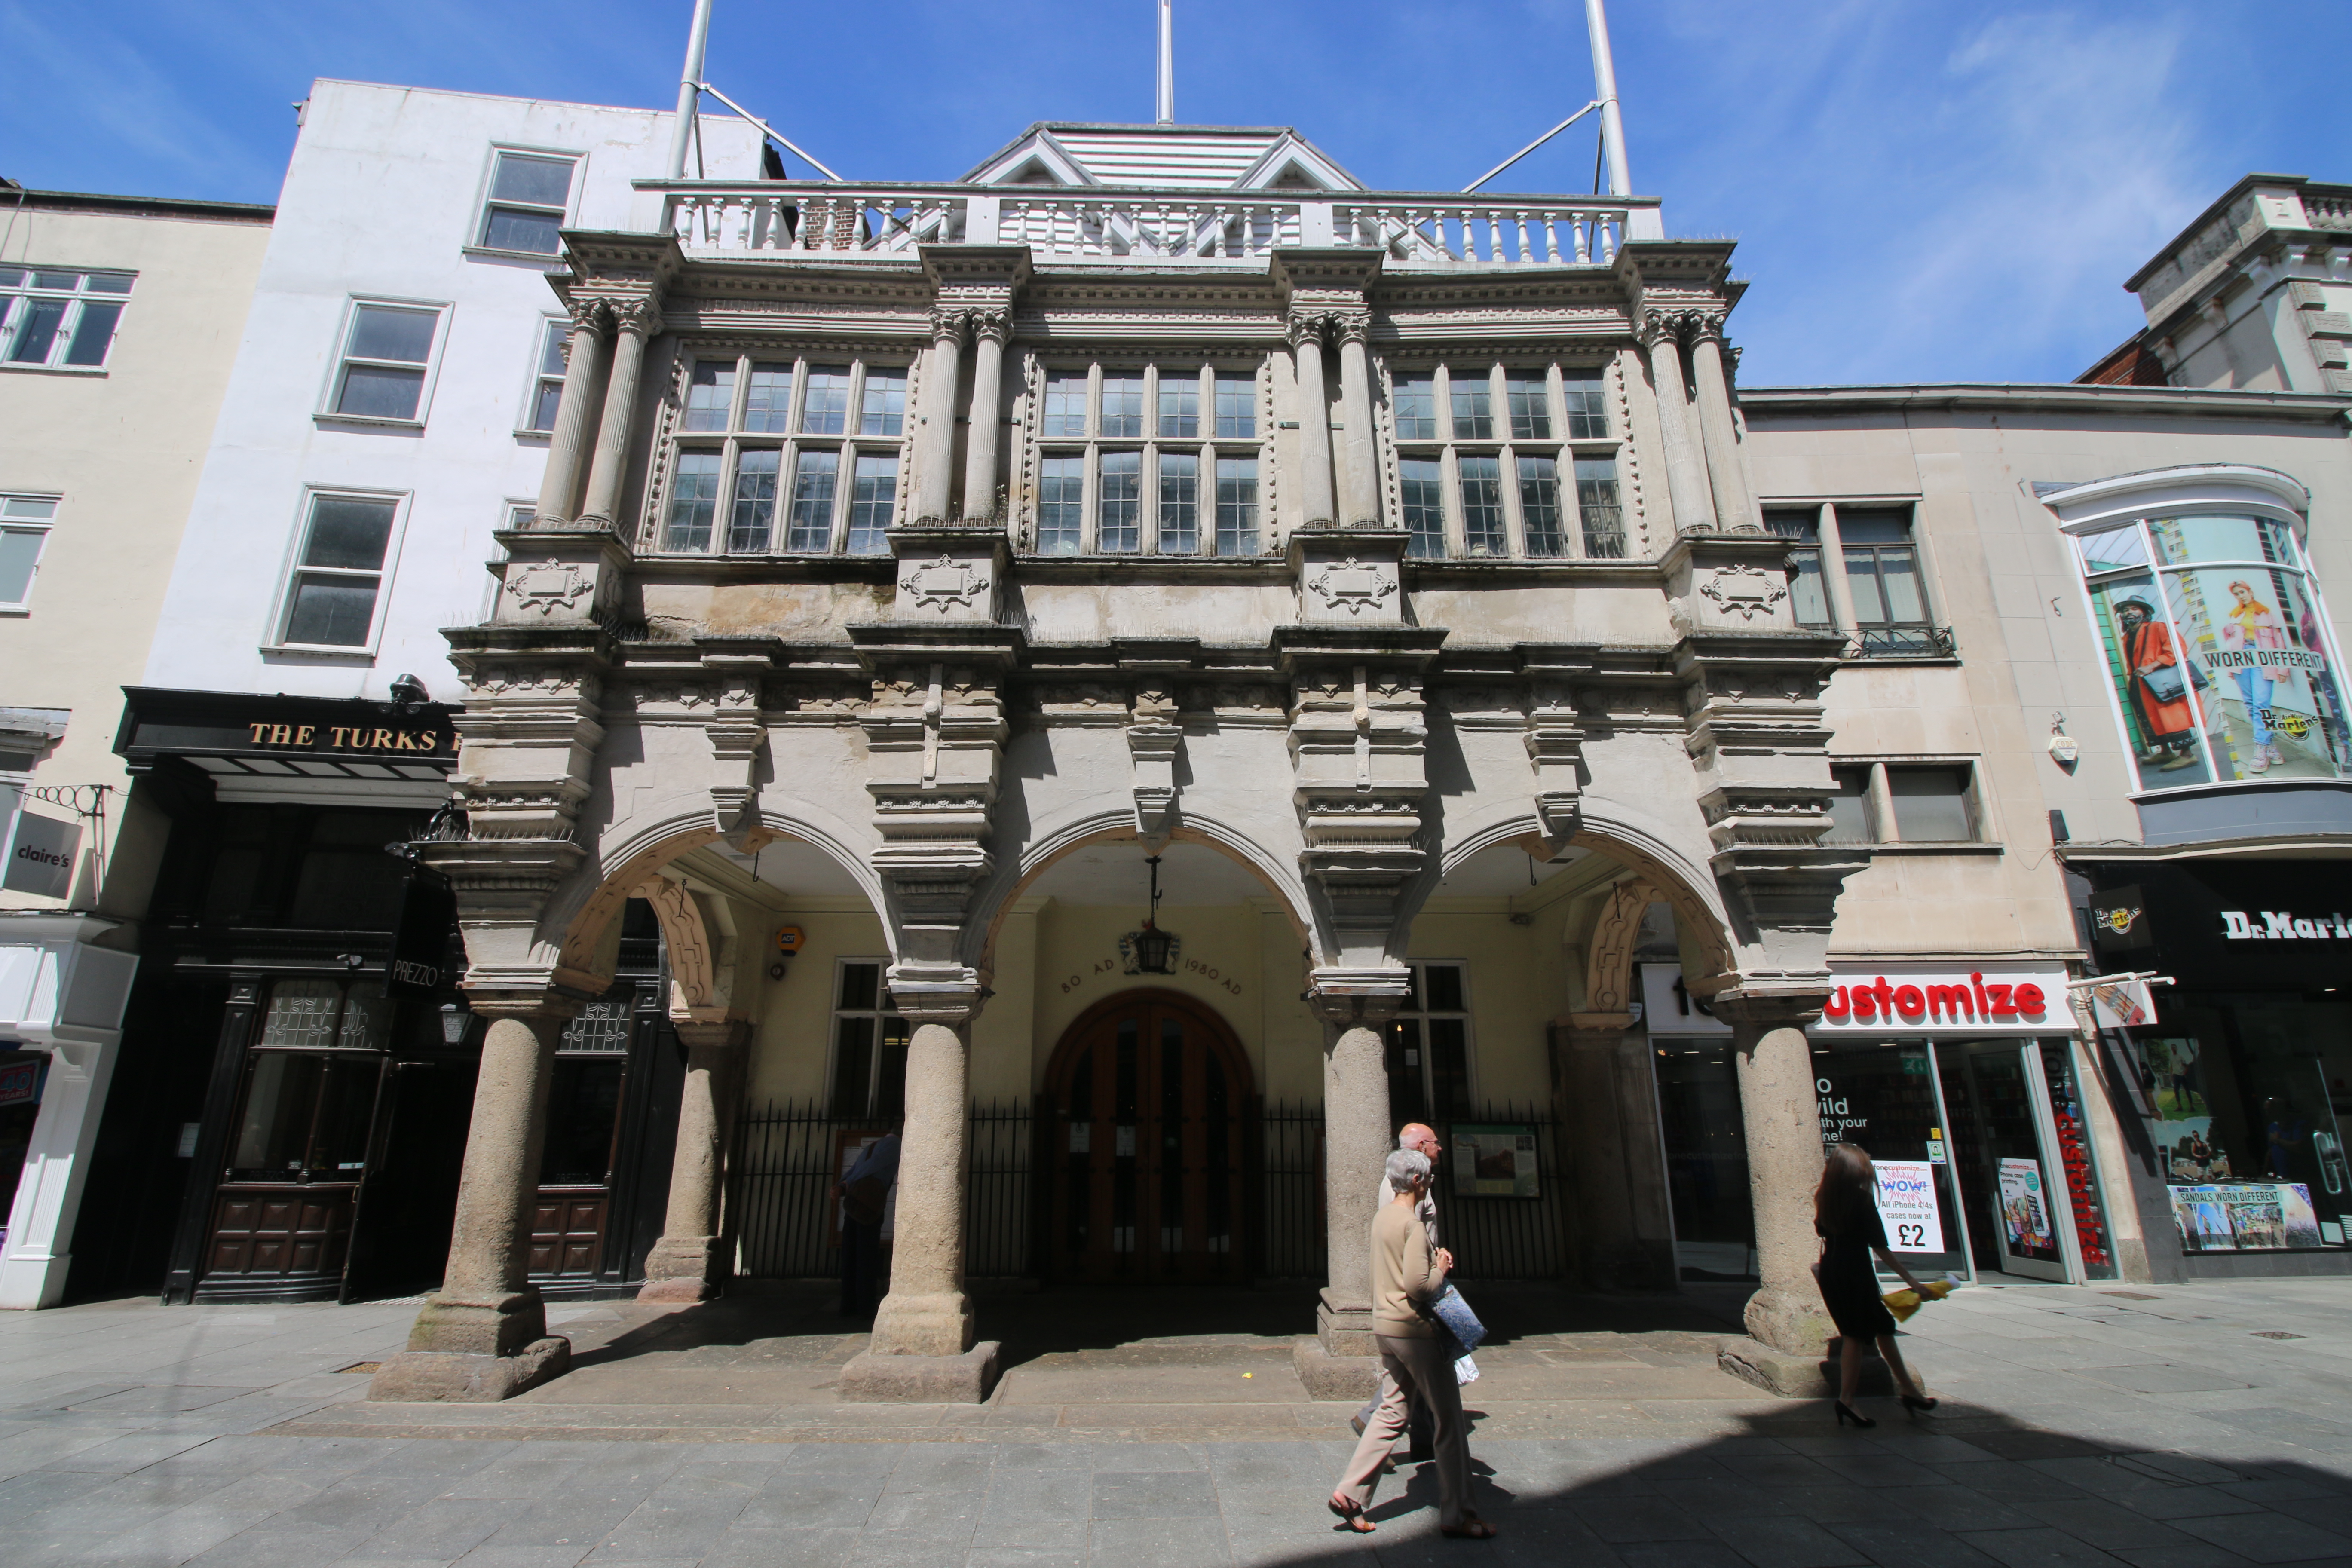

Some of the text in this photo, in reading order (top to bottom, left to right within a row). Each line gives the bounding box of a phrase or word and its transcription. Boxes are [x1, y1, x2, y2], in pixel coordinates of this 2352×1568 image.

[2205, 652, 2322, 669] WORN DIFFERENT
[2263, 716, 2319, 730] Martens
[251, 723, 315, 745] THE
[331, 727, 437, 750] TURKS
[18, 845, 70, 868] claire's
[393, 959, 438, 987] PREZZO
[1062, 959, 1114, 993] 80 AD
[1185, 959, 1242, 995] 1980 AD
[0, 1072, 31, 1092] 40
[1838, 1119, 1868, 1130] your
[2041, 1045, 2102, 1265] fonecustomize
[555, 1173, 591, 1183] PREZZO
[1881, 1179, 1926, 1192] WOW!
[2180, 1192, 2278, 1202] SANDALS. WORN DIFFERENT
[1898, 1224, 1926, 1246] £2
